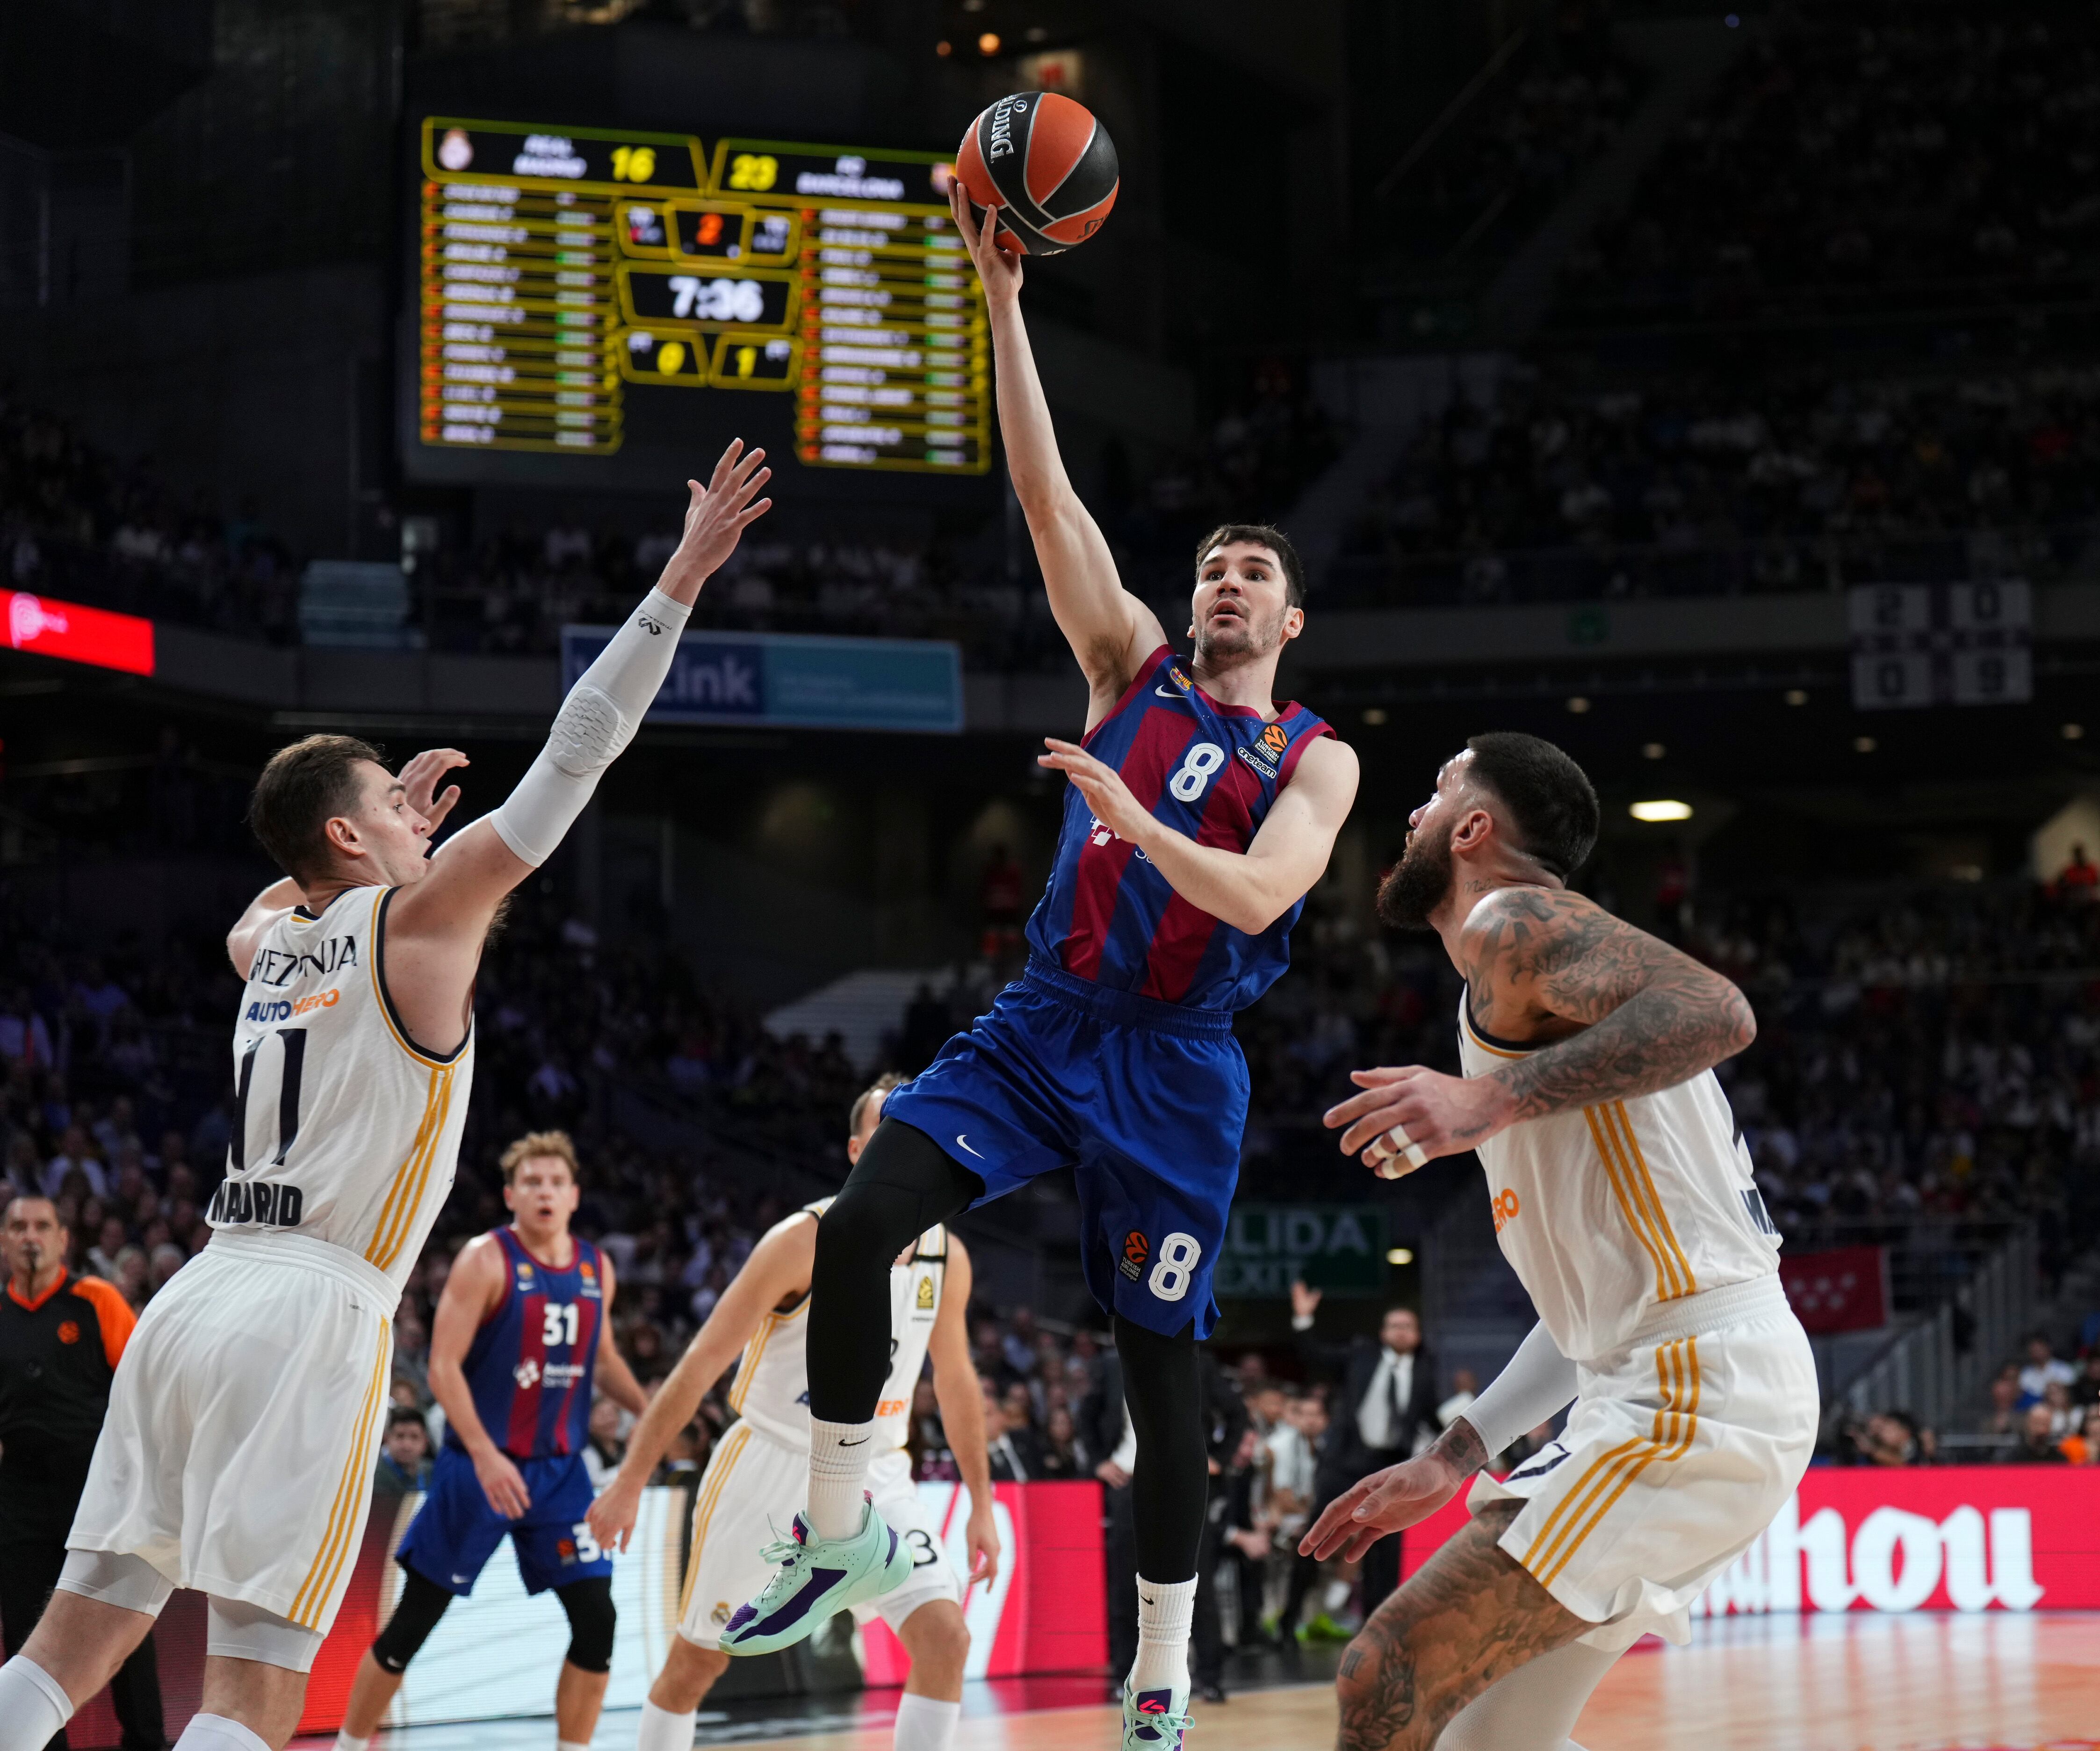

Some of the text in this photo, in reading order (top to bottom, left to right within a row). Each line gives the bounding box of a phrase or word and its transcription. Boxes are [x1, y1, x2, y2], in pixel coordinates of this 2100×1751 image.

[990, 95, 1018, 159] LDING
[611, 145, 656, 182] 16
[729, 154, 778, 191] 23
[668, 275, 764, 323] 7:36
[1239, 748, 1276, 778] oneteam
[1256, 742, 1278, 762] AIRLINES
[1259, 739, 1280, 759] TURKISH
[1170, 743, 1225, 802] 8
[230, 1028, 307, 1171] 11
[1229, 1210, 1370, 1255] LIDA
[1120, 1262, 1140, 1277] AIRLINES
[1123, 1257, 1141, 1273] TURKISH
[1148, 1232, 1202, 1301] 8
[541, 1302, 579, 1346] 31
[572, 1521, 611, 1563] 3
[902, 1529, 938, 1570] 3
[1690, 1488, 2047, 1614] hou
